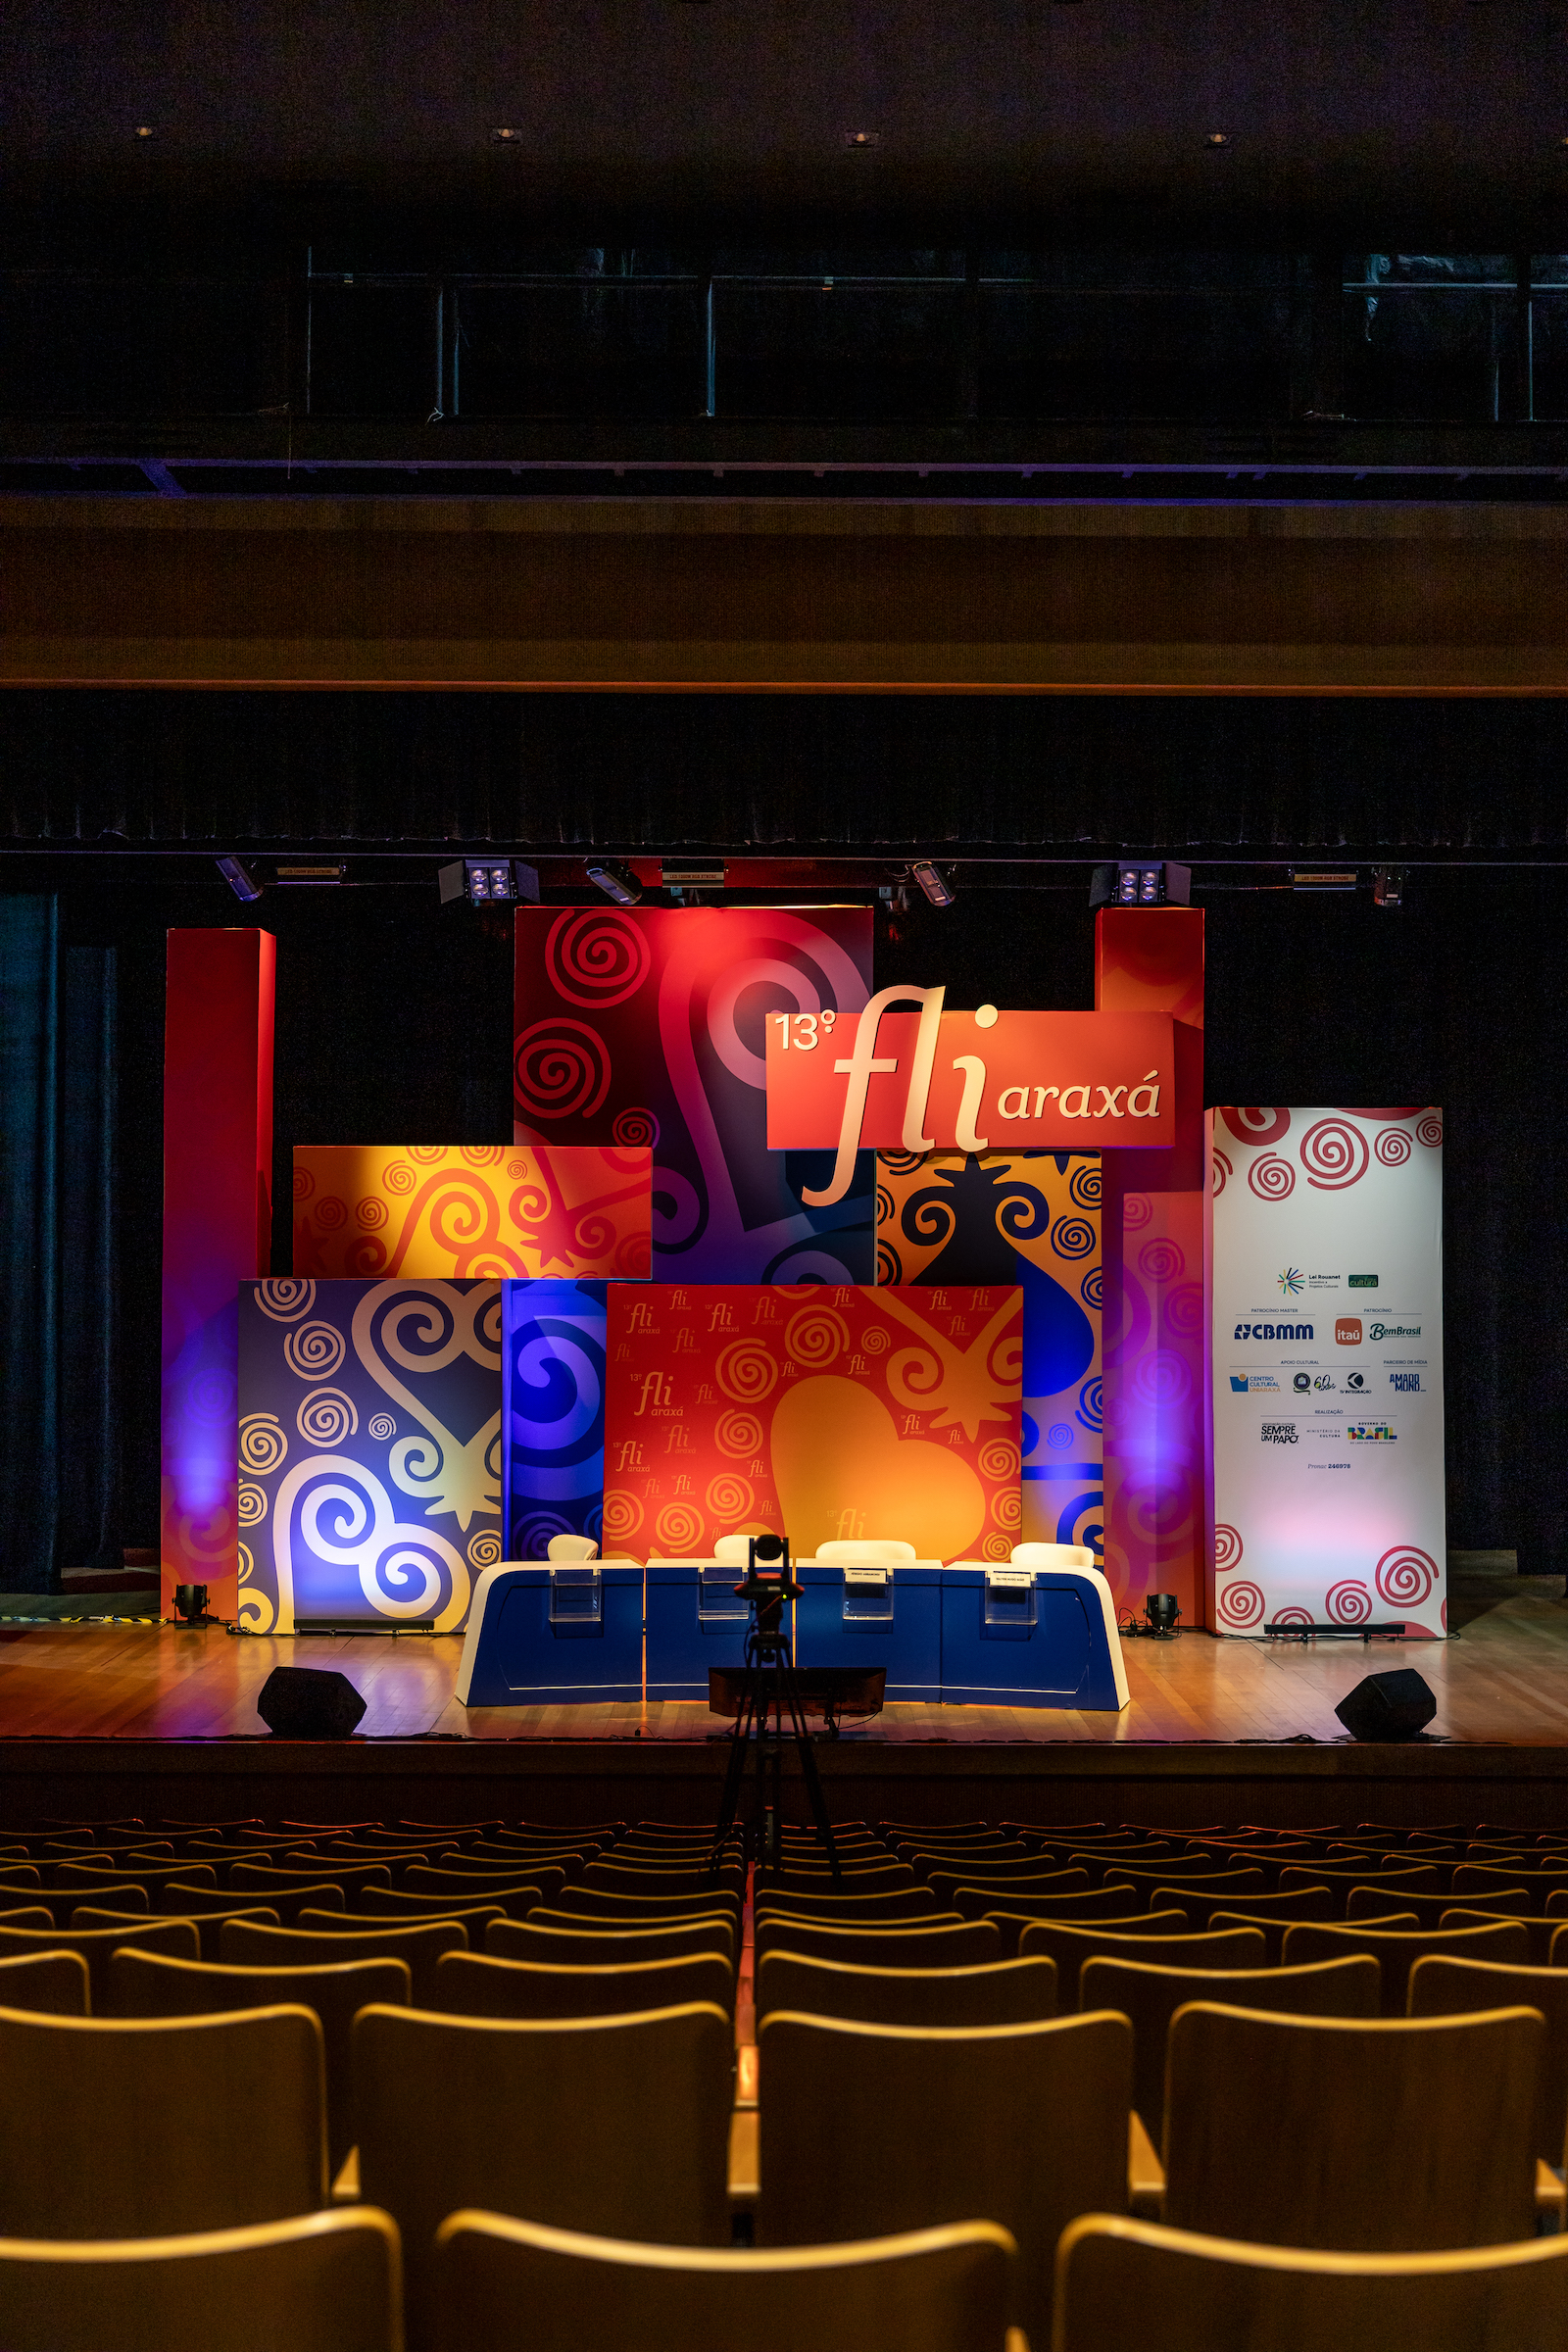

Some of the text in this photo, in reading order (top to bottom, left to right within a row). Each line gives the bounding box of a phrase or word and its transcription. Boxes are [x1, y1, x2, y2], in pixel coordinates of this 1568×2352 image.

[801, 985, 999, 1207] fli
[998, 1069, 1160, 1119] araxá
[1349, 1277, 1378, 1287] cultura
[669, 1290, 687, 1310] fli
[832, 1287, 851, 1307] fli
[929, 1290, 948, 1310] fli
[969, 1288, 990, 1311] fli
[626, 1302, 654, 1334] fli
[707, 1302, 734, 1332] fli
[752, 1296, 777, 1325] fli
[948, 1315, 966, 1336] fli
[1251, 1324, 1314, 1340] CBMM
[1337, 1329, 1360, 1341] itaú
[672, 1328, 696, 1353] fli
[781, 1361, 796, 1377] fli
[848, 1354, 866, 1375] fli
[634, 1371, 674, 1416] fli
[651, 1406, 684, 1417] araxá
[903, 1414, 921, 1435] fli
[1260, 1425, 1297, 1435] SEMPRE
[1348, 1427, 1397, 1440] BRASIL
[664, 1424, 690, 1454] fli
[948, 1429, 961, 1445] fli
[615, 1441, 644, 1472] fli
[748, 1459, 764, 1478] fli
[643, 1478, 661, 1499] fli
[673, 1474, 692, 1495] fli
[760, 1499, 773, 1516] fli
[835, 1507, 866, 1542] fli
